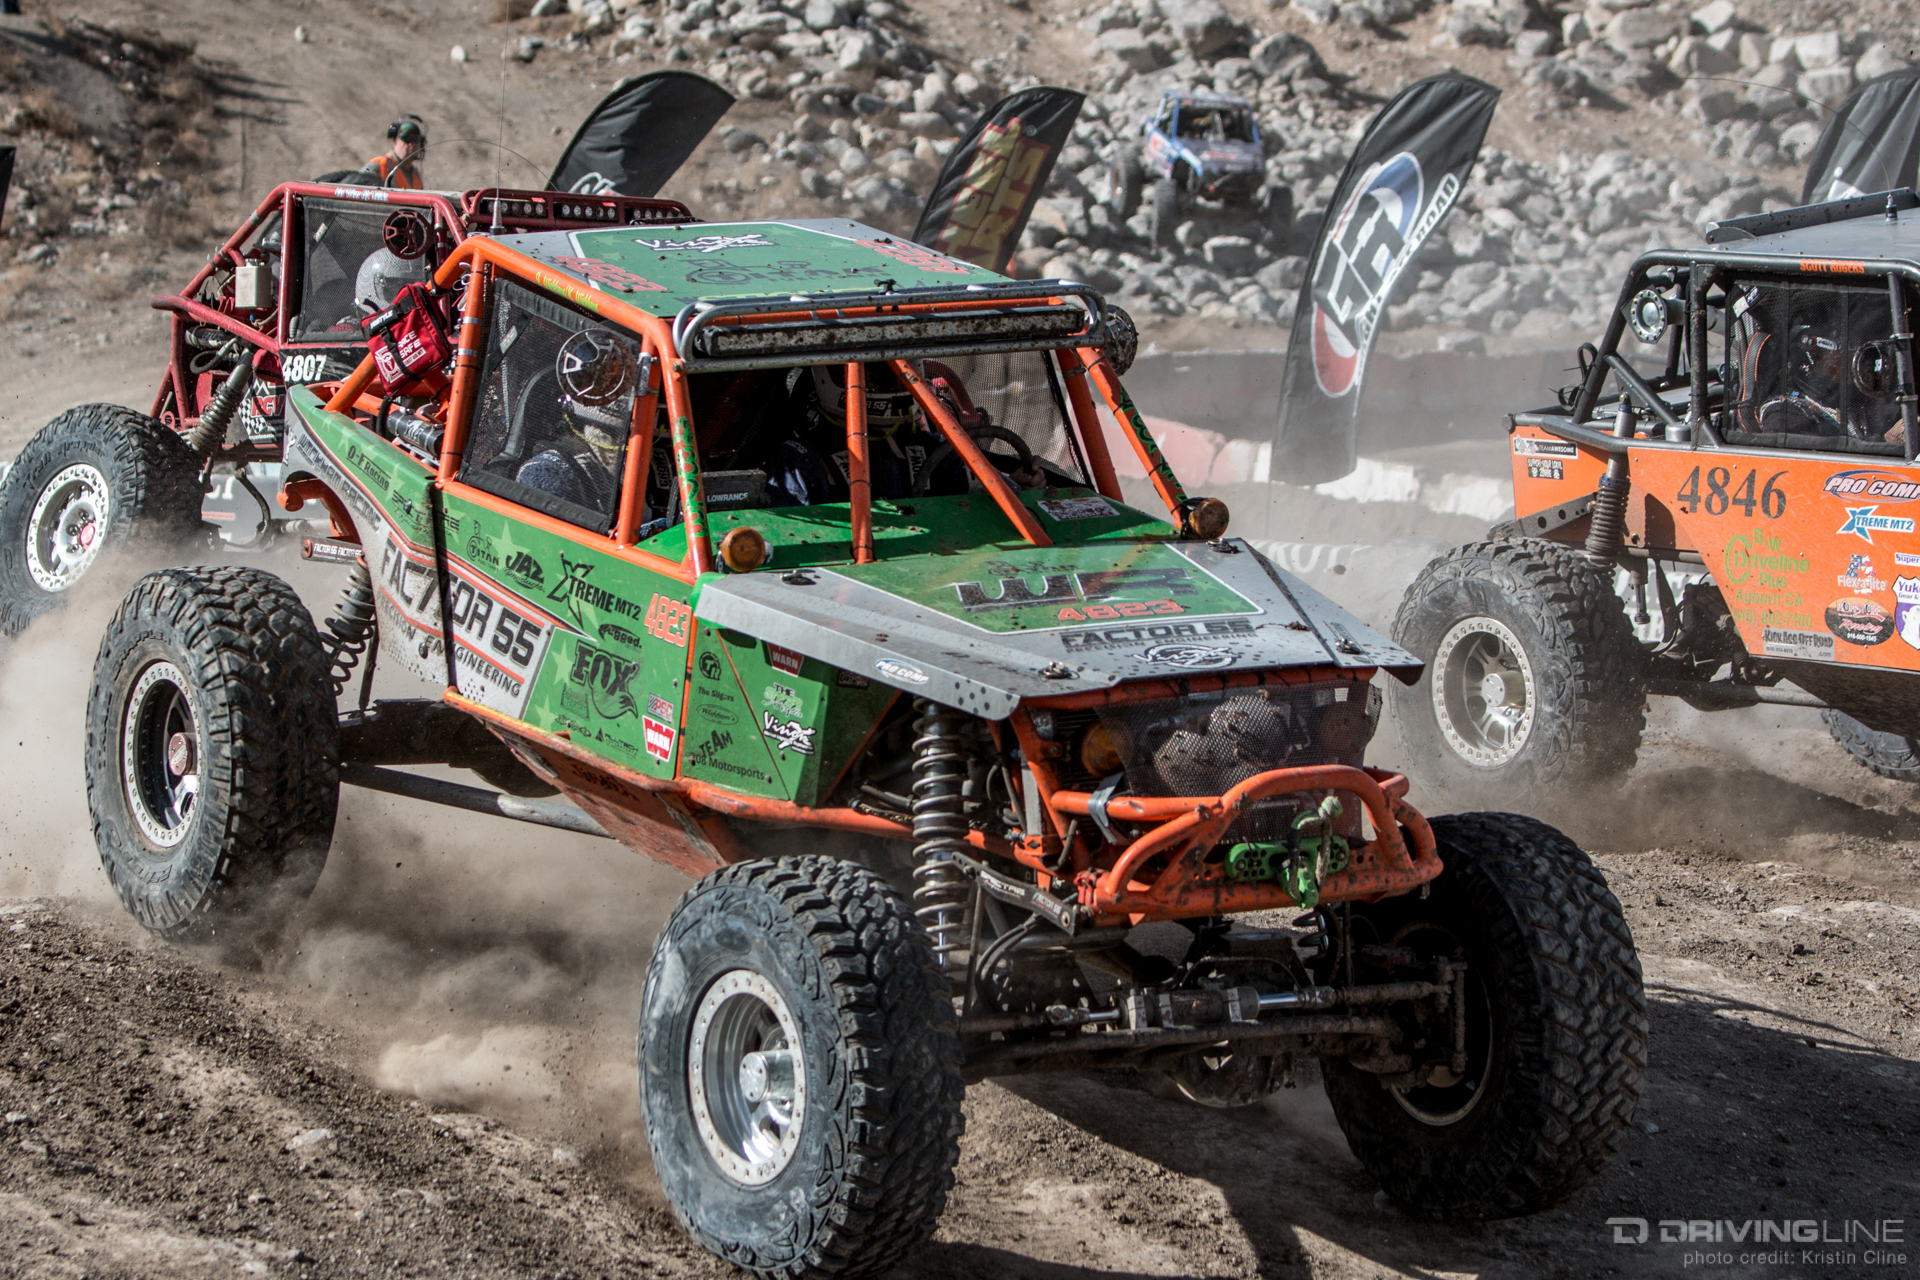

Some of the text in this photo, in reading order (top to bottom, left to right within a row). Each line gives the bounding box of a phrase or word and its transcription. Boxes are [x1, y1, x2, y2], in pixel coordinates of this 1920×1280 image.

[1799, 258, 1866, 275] SCOTT ROGERS
[399, 338, 422, 359] SAFE
[282, 354, 327, 383] 4807
[364, 461, 391, 492] Racing
[1822, 476, 1867, 493] PRO
[706, 492, 750, 503] LOWRANCE
[1676, 465, 1789, 520] 4846
[1836, 504, 1915, 546] XTREME MT2
[470, 542, 500, 566] TITAN
[1733, 549, 1810, 573] Driveline
[505, 550, 545, 584] JAZ
[547, 555, 642, 630] XTREME MT2
[1758, 571, 1787, 590] Plus
[1734, 588, 1803, 608] Auburn CA
[643, 591, 692, 648] 4823
[1057, 599, 1186, 622] 4823
[1760, 611, 1813, 629] 802-7100
[490, 604, 544, 669] 55
[1059, 617, 1257, 649] FACTOR 55
[1764, 629, 1784, 644] KICK
[1783, 630, 1798, 645] ASS
[1813, 633, 1834, 649] ROAD
[571, 641, 639, 697] FOX
[772, 651, 799, 670] WARN
[875, 660, 930, 683] PRO COMP
[698, 686, 710, 698] The
[698, 729, 734, 758] TEAM
[708, 757, 766, 781] Motorsports
[1032, 891, 1055, 909] FACTOR
